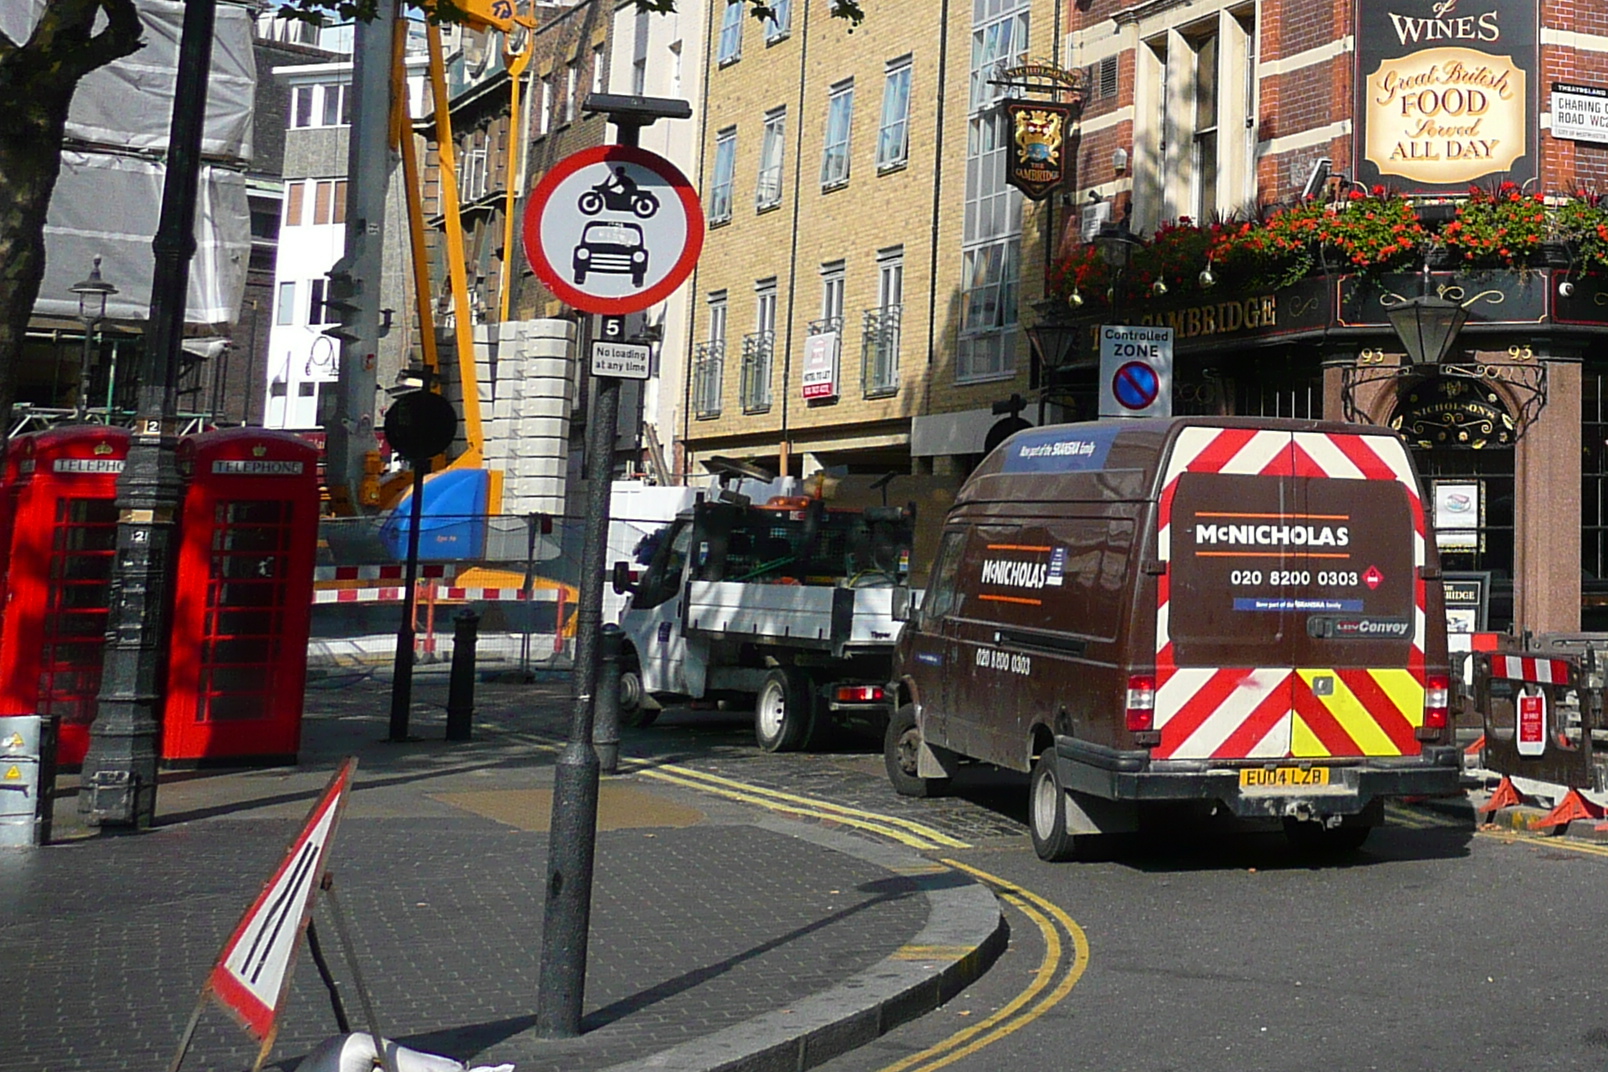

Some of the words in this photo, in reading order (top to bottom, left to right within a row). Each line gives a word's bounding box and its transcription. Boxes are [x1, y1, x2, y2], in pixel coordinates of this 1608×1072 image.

[1388, 10, 1500, 46] WINES
[1376, 65, 1441, 106] Great
[1437, 61, 1515, 101] British
[1401, 88, 1490, 116] FOOD
[1558, 97, 1601, 114] CHARING
[1558, 111, 1585, 125] ROAD
[1404, 118, 1482, 138] Served
[1389, 140, 1440, 161] ALL
[1446, 139, 1500, 160] DAY
[1030, 162, 1046, 170] THE
[1015, 168, 1060, 182] CAMBRIDGE
[606, 319, 620, 335] 5
[1105, 329, 1169, 342] Controlled
[596, 347, 610, 356] No
[612, 348, 646, 361] loading
[1113, 343, 1158, 358] ZONE
[1361, 348, 1384, 362] 93
[1508, 345, 1532, 359] 93
[596, 360, 605, 370] at
[607, 362, 624, 371] any
[626, 362, 646, 372] time
[1412, 402, 1496, 420] NICHOLSON'S
[149, 420, 159, 431] 2
[218, 461, 301, 474] TELEPHONE
[134, 530, 144, 542] 2
[1195, 524, 1349, 547] McNICHOLAS
[981, 559, 1048, 589] McNICHOLAS
[1231, 570, 1263, 585] 020
[1269, 570, 1311, 586] 8200
[1317, 571, 1359, 586] 0303
[1445, 590, 1476, 600] RIDGE
[1359, 620, 1409, 635] Convoy
[976, 647, 990, 667] 020
[1011, 654, 1030, 676] 0303
[1247, 769, 1287, 785] EU04
[1291, 769, 1322, 785] LZB
